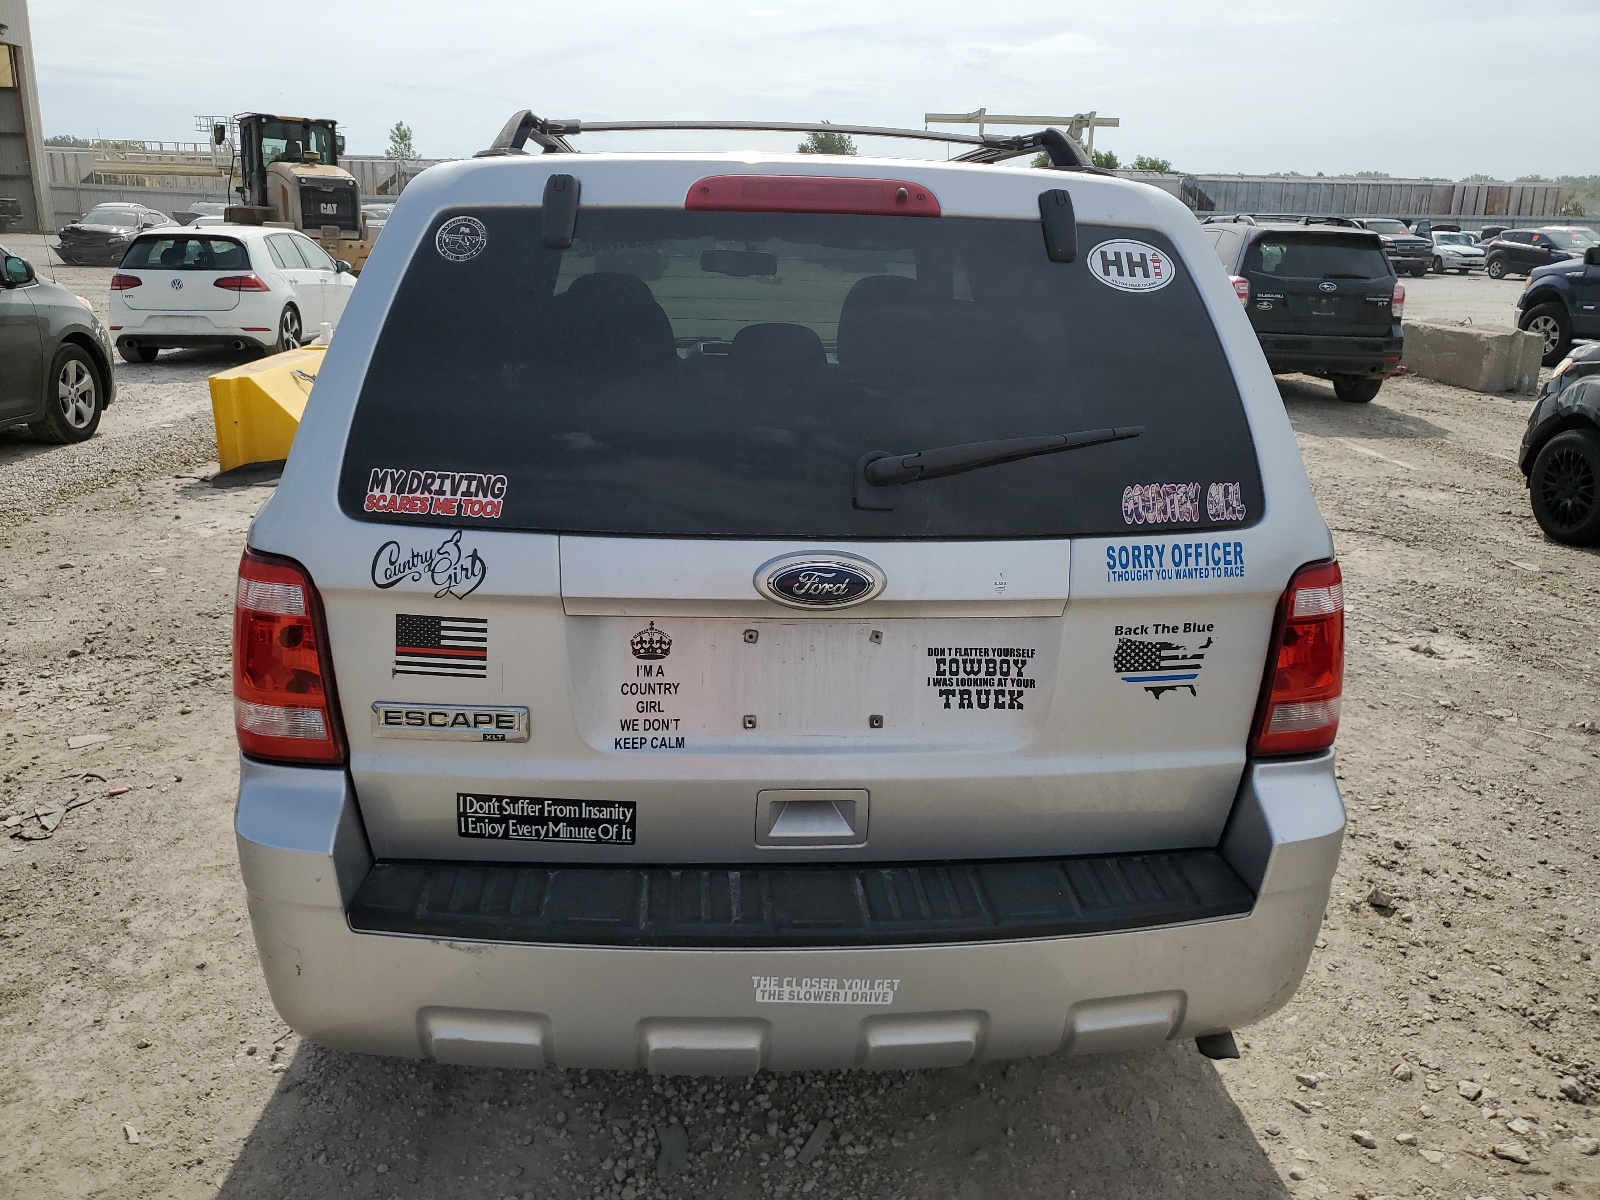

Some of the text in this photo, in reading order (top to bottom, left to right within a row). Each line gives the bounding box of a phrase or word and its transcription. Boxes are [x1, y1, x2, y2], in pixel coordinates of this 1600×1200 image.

[320, 203, 337, 214] CAT
[369, 468, 507, 498] MY DRIVING
[365, 494, 502, 517] SCARES ME TOO!
[1122, 482, 1246, 524] COUNTRY GIRL
[1107, 541, 1244, 570] SORRY OFFICER
[371, 540, 486, 600] Country Girl
[1107, 566, 1245, 582] I THOUGHT YOU WANTED TO RACE
[793, 571, 850, 595] Ford
[1114, 622, 1214, 636] Back The Blue
[955, 647, 989, 657] FLATTER
[991, 647, 1036, 658] YOURSELF
[636, 665, 665, 677] I'M A
[935, 658, 1027, 677] COWBOY
[621, 682, 680, 695] COUNTRY
[927, 677, 1036, 688] I WAS LOOKING AT YOUR
[636, 701, 664, 713] GIRL
[938, 689, 1024, 710] TRUCK
[384, 710, 515, 730] ESCAPE
[620, 718, 681, 731] WE DON'T
[614, 736, 685, 750] KEEP CALM
[459, 796, 633, 822] I Don't Suffer From Insanity
[461, 816, 633, 840] I Enjoy Every Minute Of It
[752, 976, 900, 991] THE CLOSER YOU GET
[760, 989, 890, 1002] THE SLOWER I DRIVE
